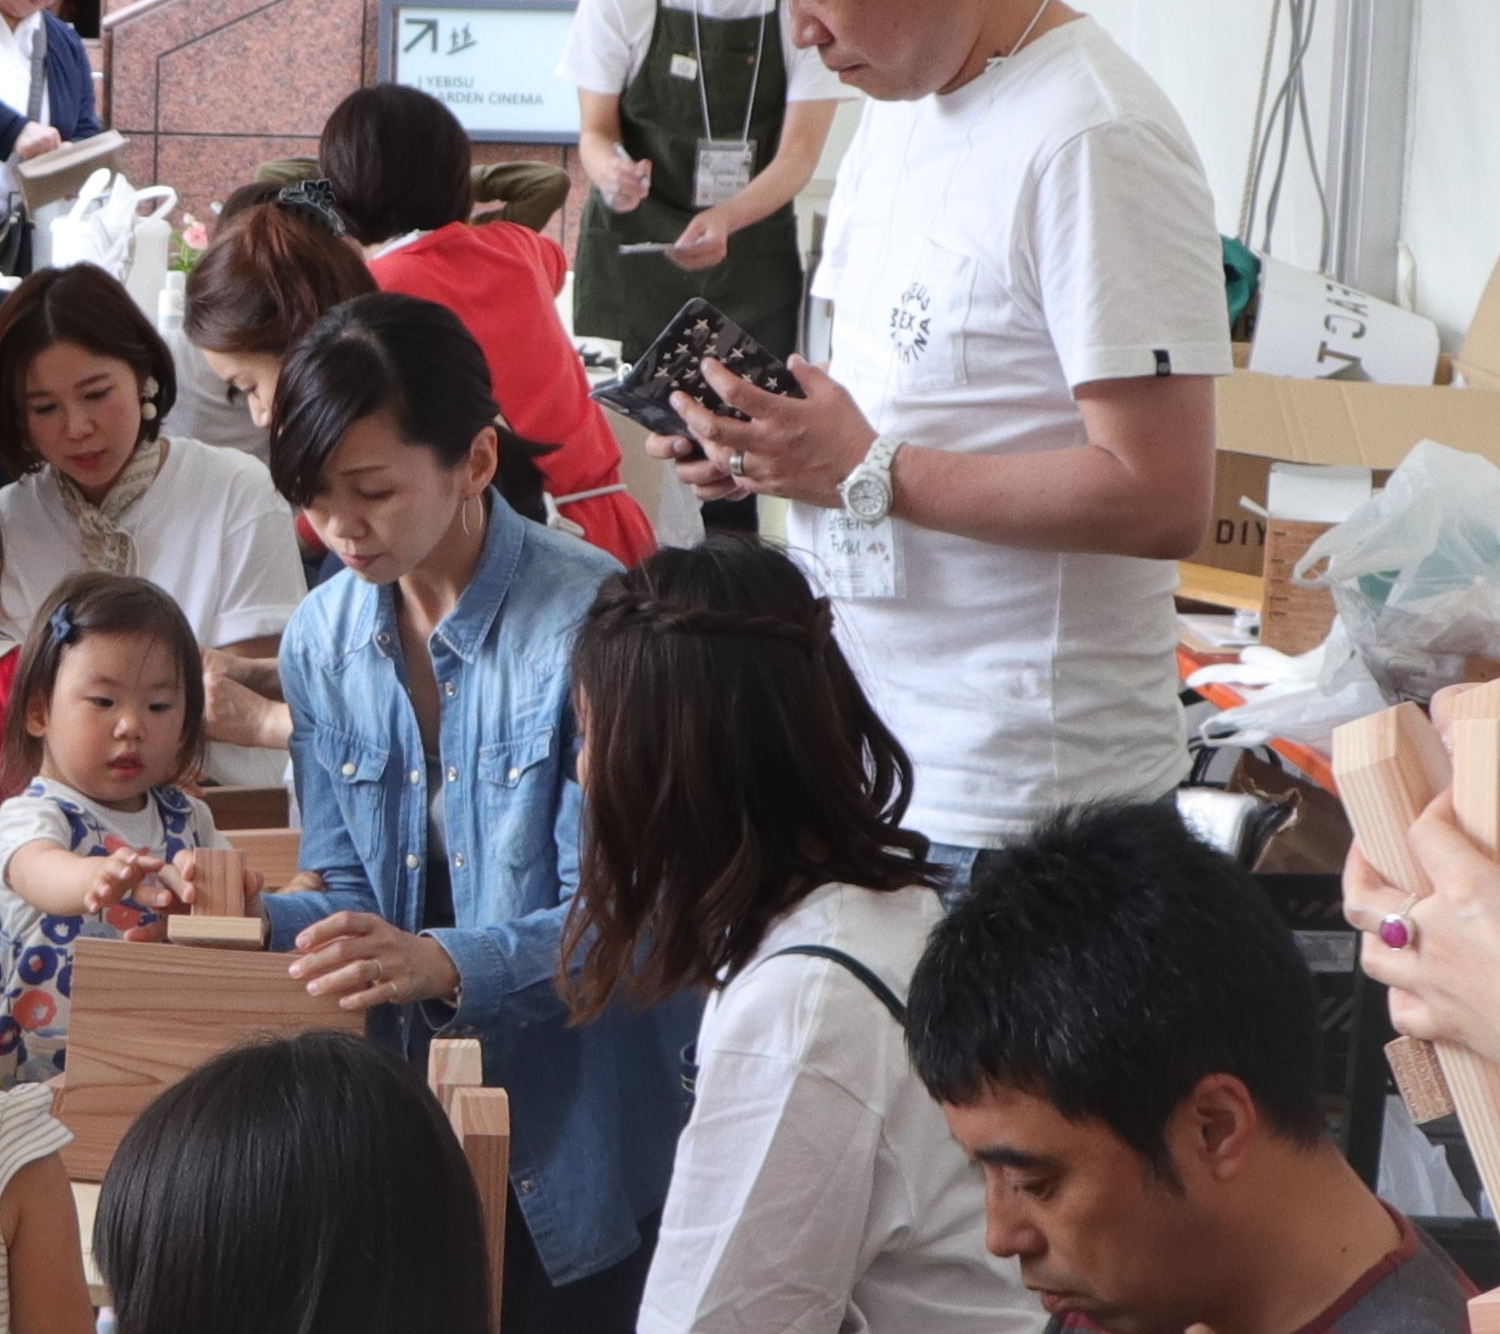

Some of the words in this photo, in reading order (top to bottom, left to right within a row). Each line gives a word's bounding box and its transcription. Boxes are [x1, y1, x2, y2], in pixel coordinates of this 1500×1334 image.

[425, 75, 474, 89] YEBISU
[432, 91, 484, 104] ARDEN
[488, 93, 544, 105] CINEMA
